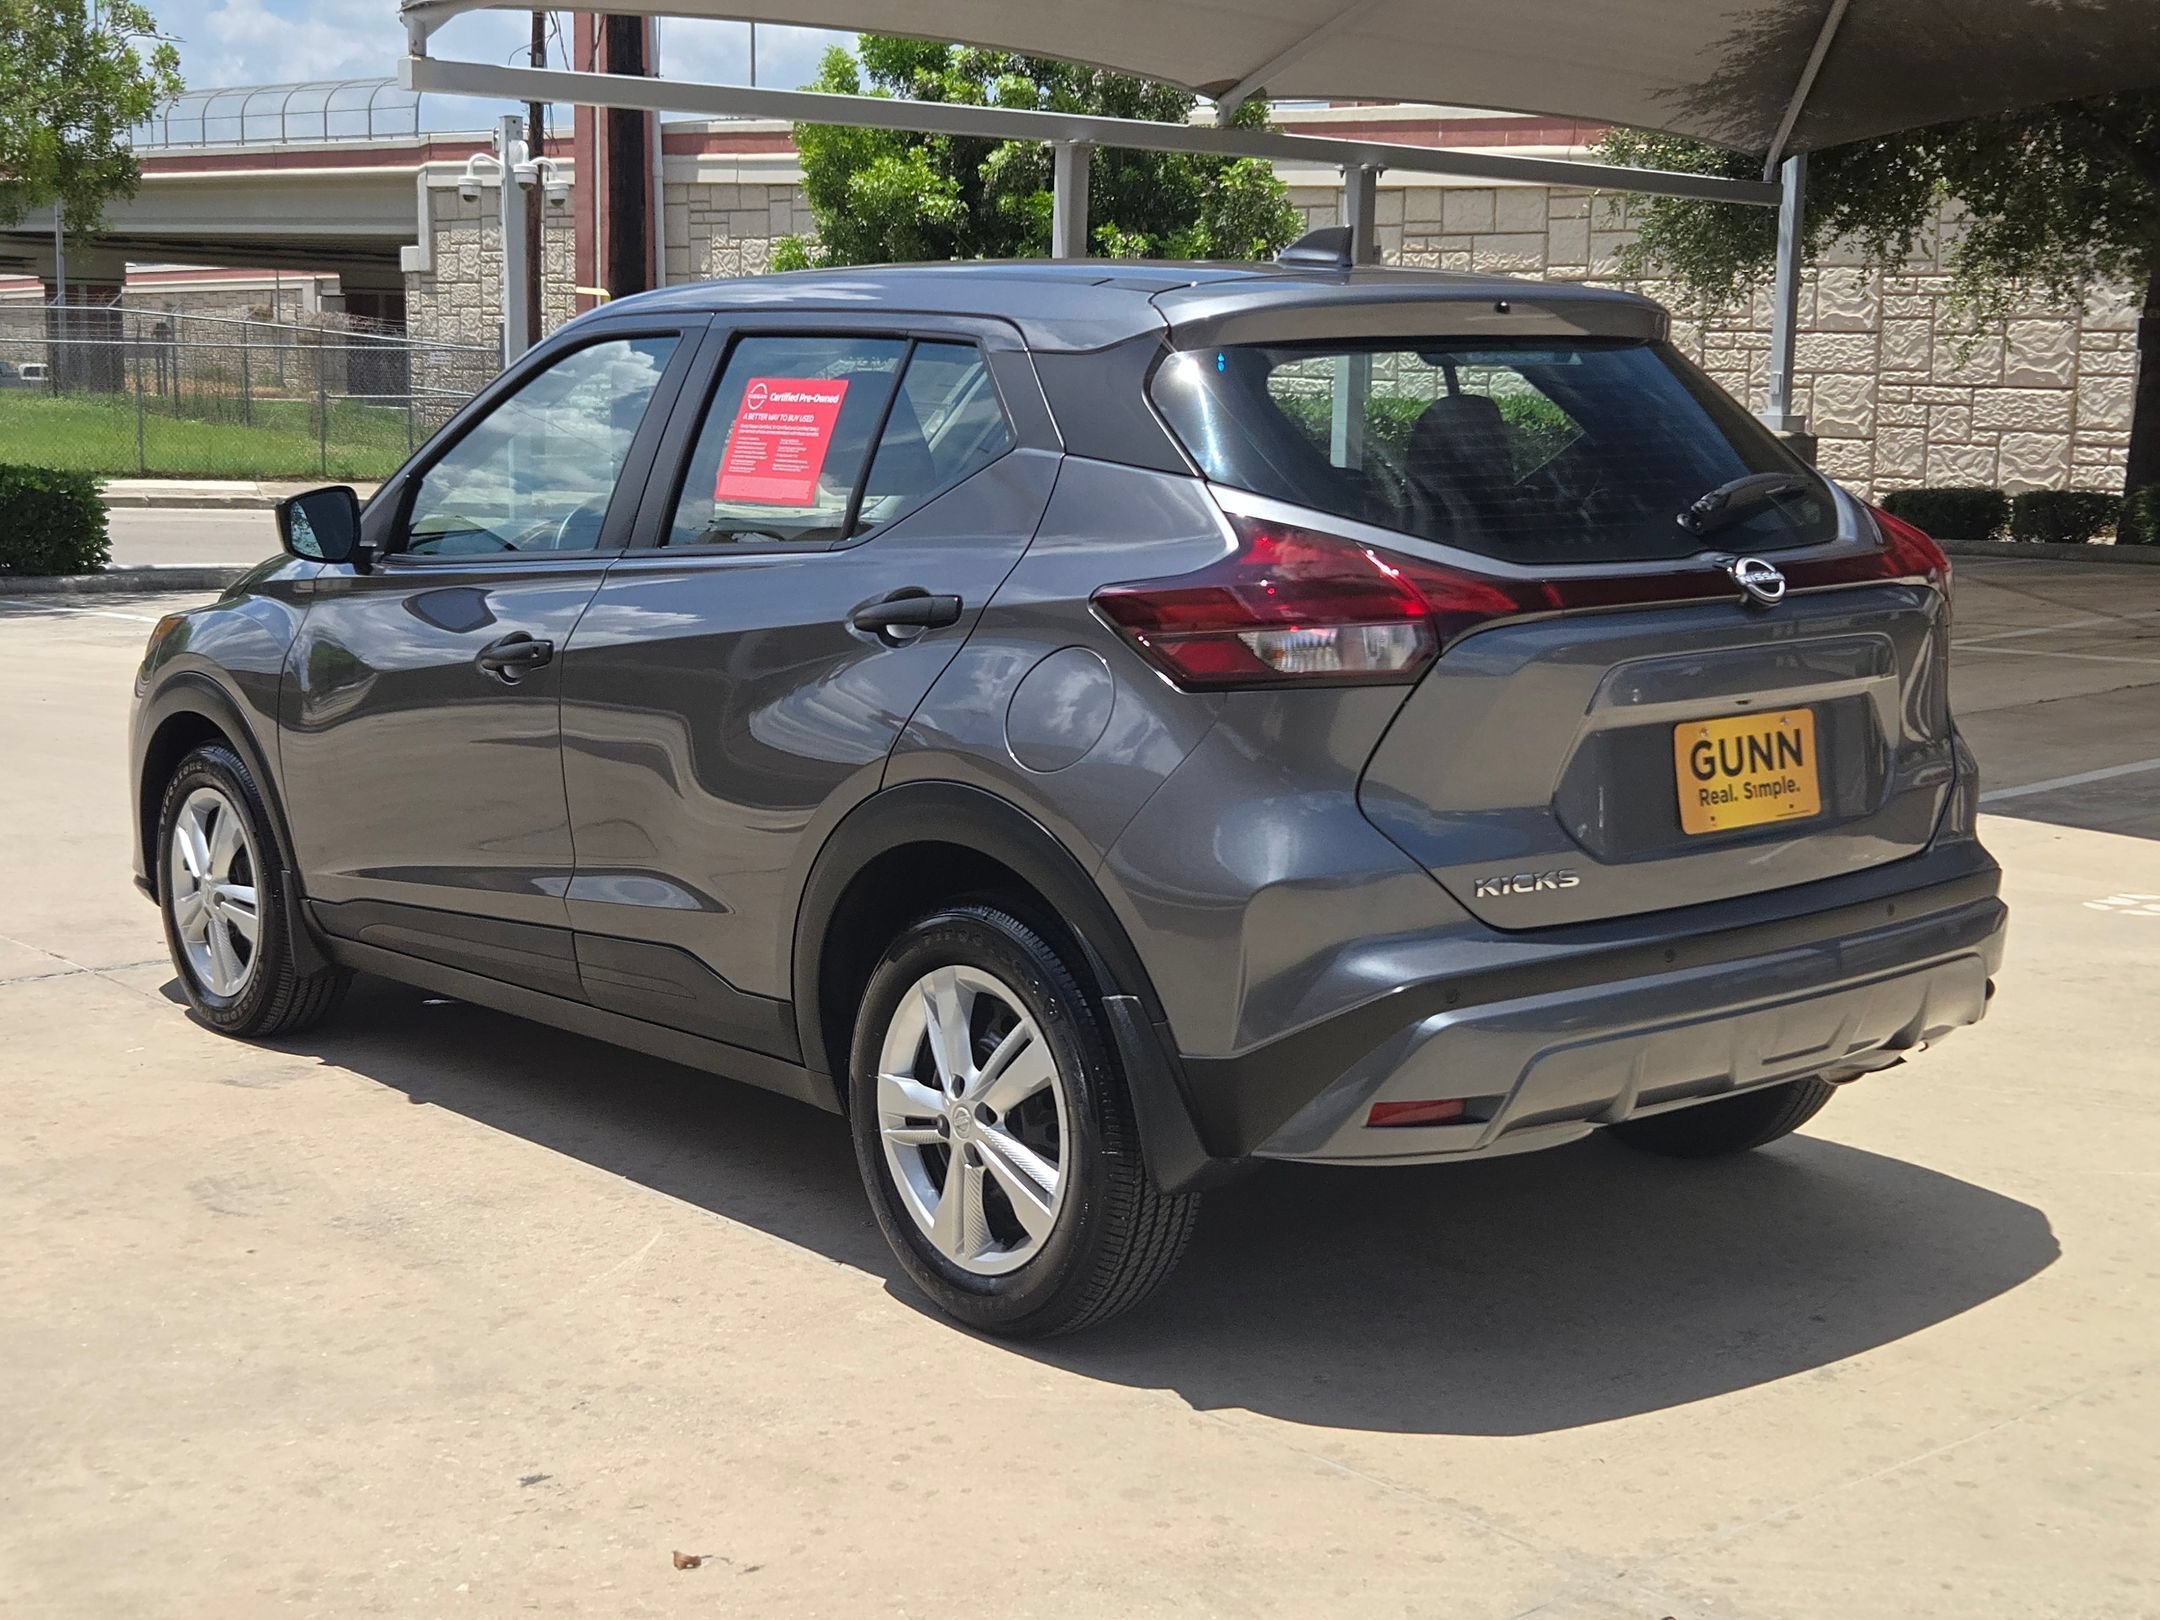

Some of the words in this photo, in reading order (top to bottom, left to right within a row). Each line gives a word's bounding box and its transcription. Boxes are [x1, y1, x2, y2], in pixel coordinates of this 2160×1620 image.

[769, 392, 800, 402] Certified
[800, 393, 840, 404] Pre-Owned
[748, 413, 768, 421] BETTER
[788, 414, 800, 422] BUY
[799, 414, 815, 423] USED
[1690, 728, 1803, 781] GUNN
[1698, 784, 1738, 807] Real.
[1743, 775, 1801, 799] Simple.
[1475, 868, 1580, 898] KICKS
